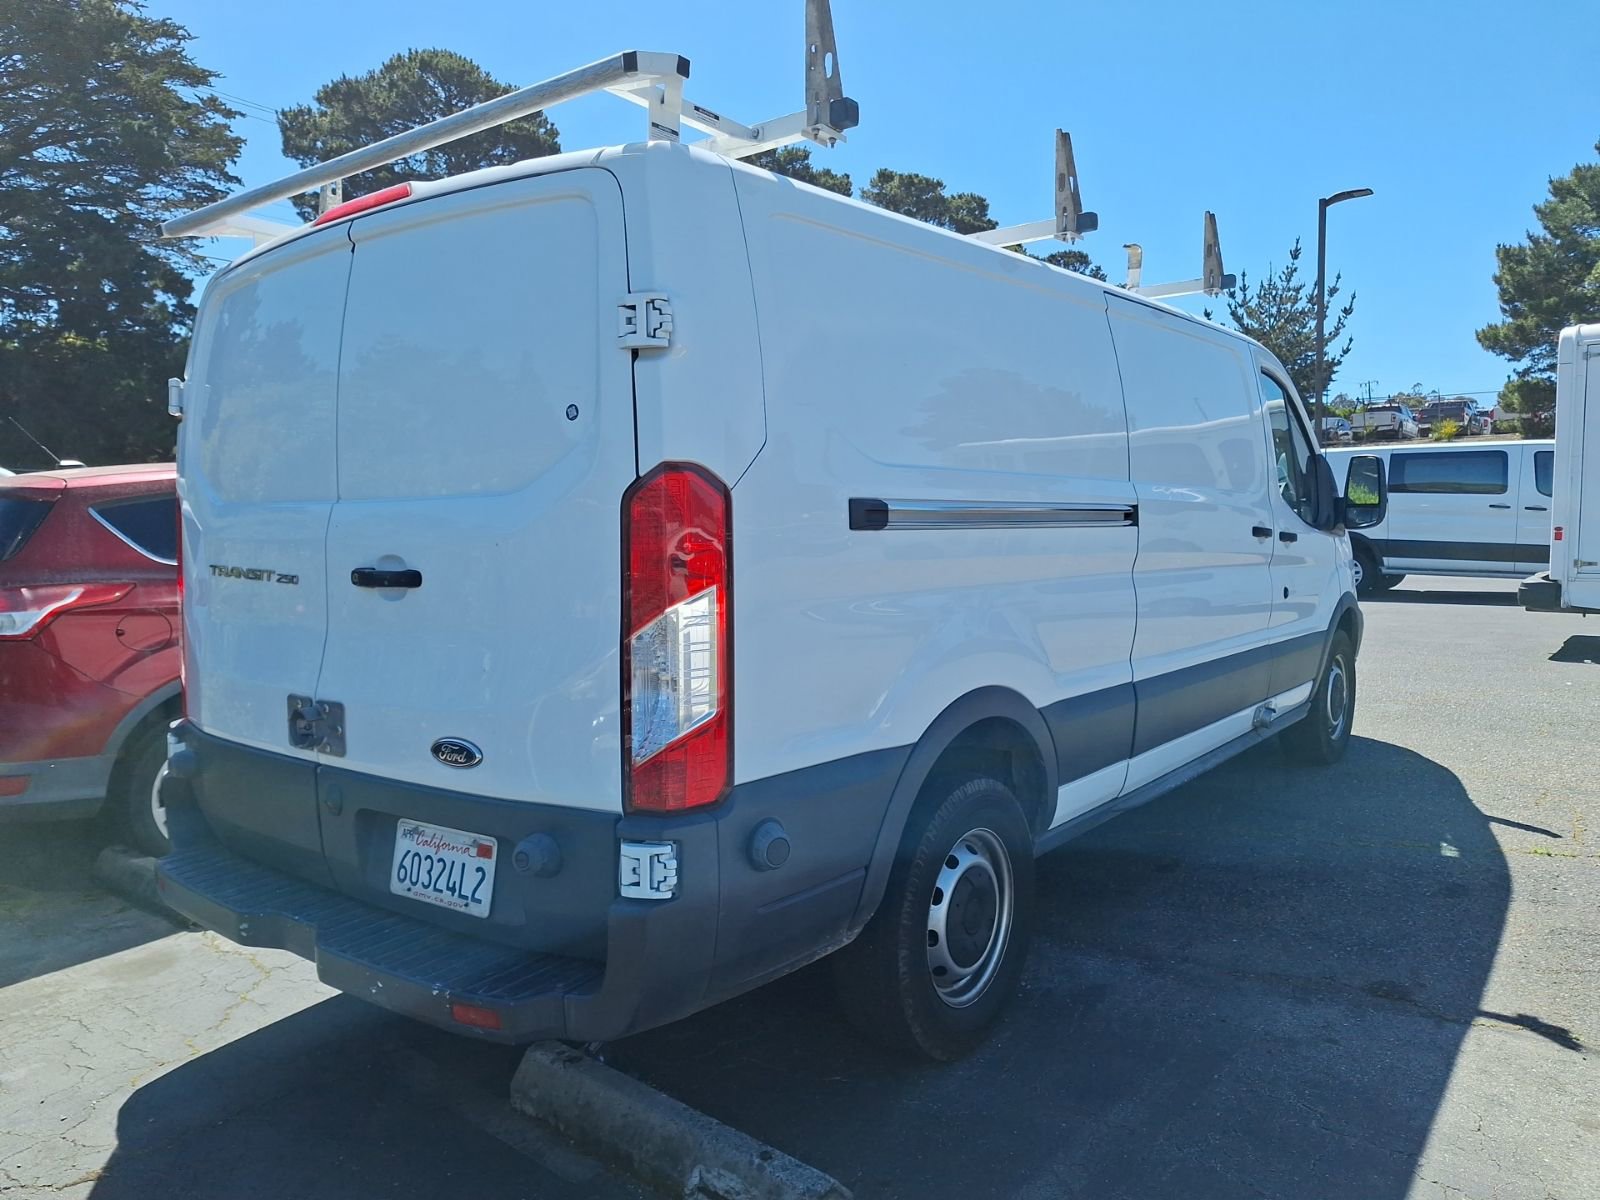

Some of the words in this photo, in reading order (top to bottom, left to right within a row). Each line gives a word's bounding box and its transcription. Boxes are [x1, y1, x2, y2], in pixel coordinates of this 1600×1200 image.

[209, 564, 276, 582] TRANSIT
[276, 573, 299, 585] 250
[438, 743, 468, 763] Ford
[415, 829, 476, 858] California
[397, 849, 487, 905] 60324L2
